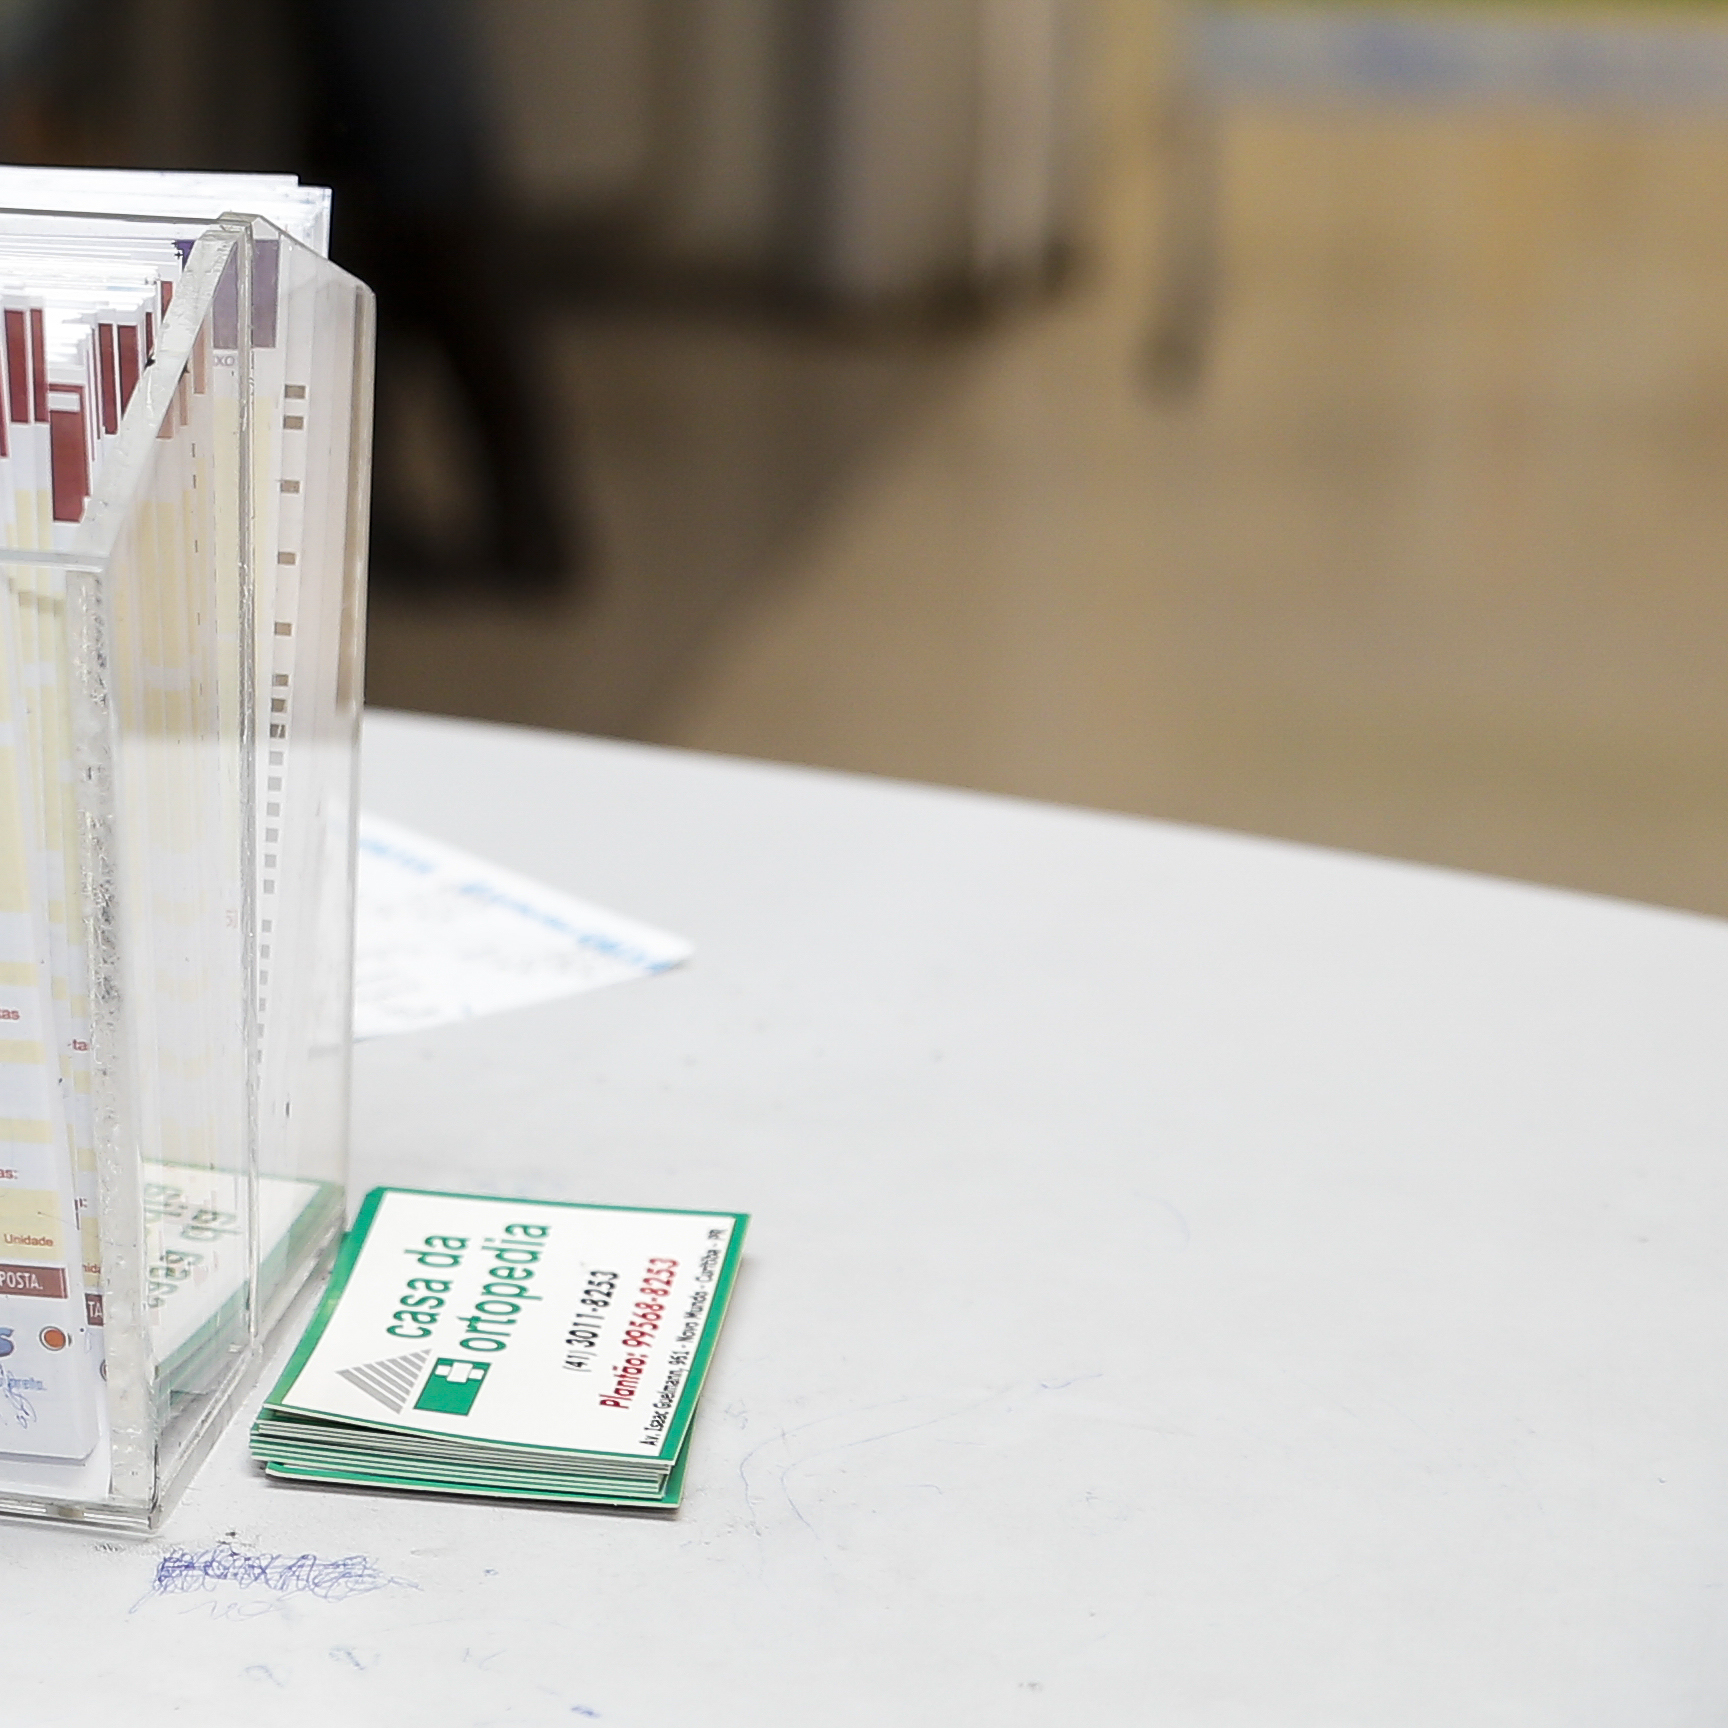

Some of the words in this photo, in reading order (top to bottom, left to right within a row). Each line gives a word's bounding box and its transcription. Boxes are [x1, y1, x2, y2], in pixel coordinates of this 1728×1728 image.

[405, 1234, 469, 1269] da
[386, 1277, 454, 1339] casa
[458, 1222, 552, 1352] ortopedia
[566, 1271, 621, 1348] 3011-8253
[622, 1258, 680, 1350] 99568-8253
[562, 1345, 592, 1373] (41)
[600, 1352, 649, 1410] Plantão:
